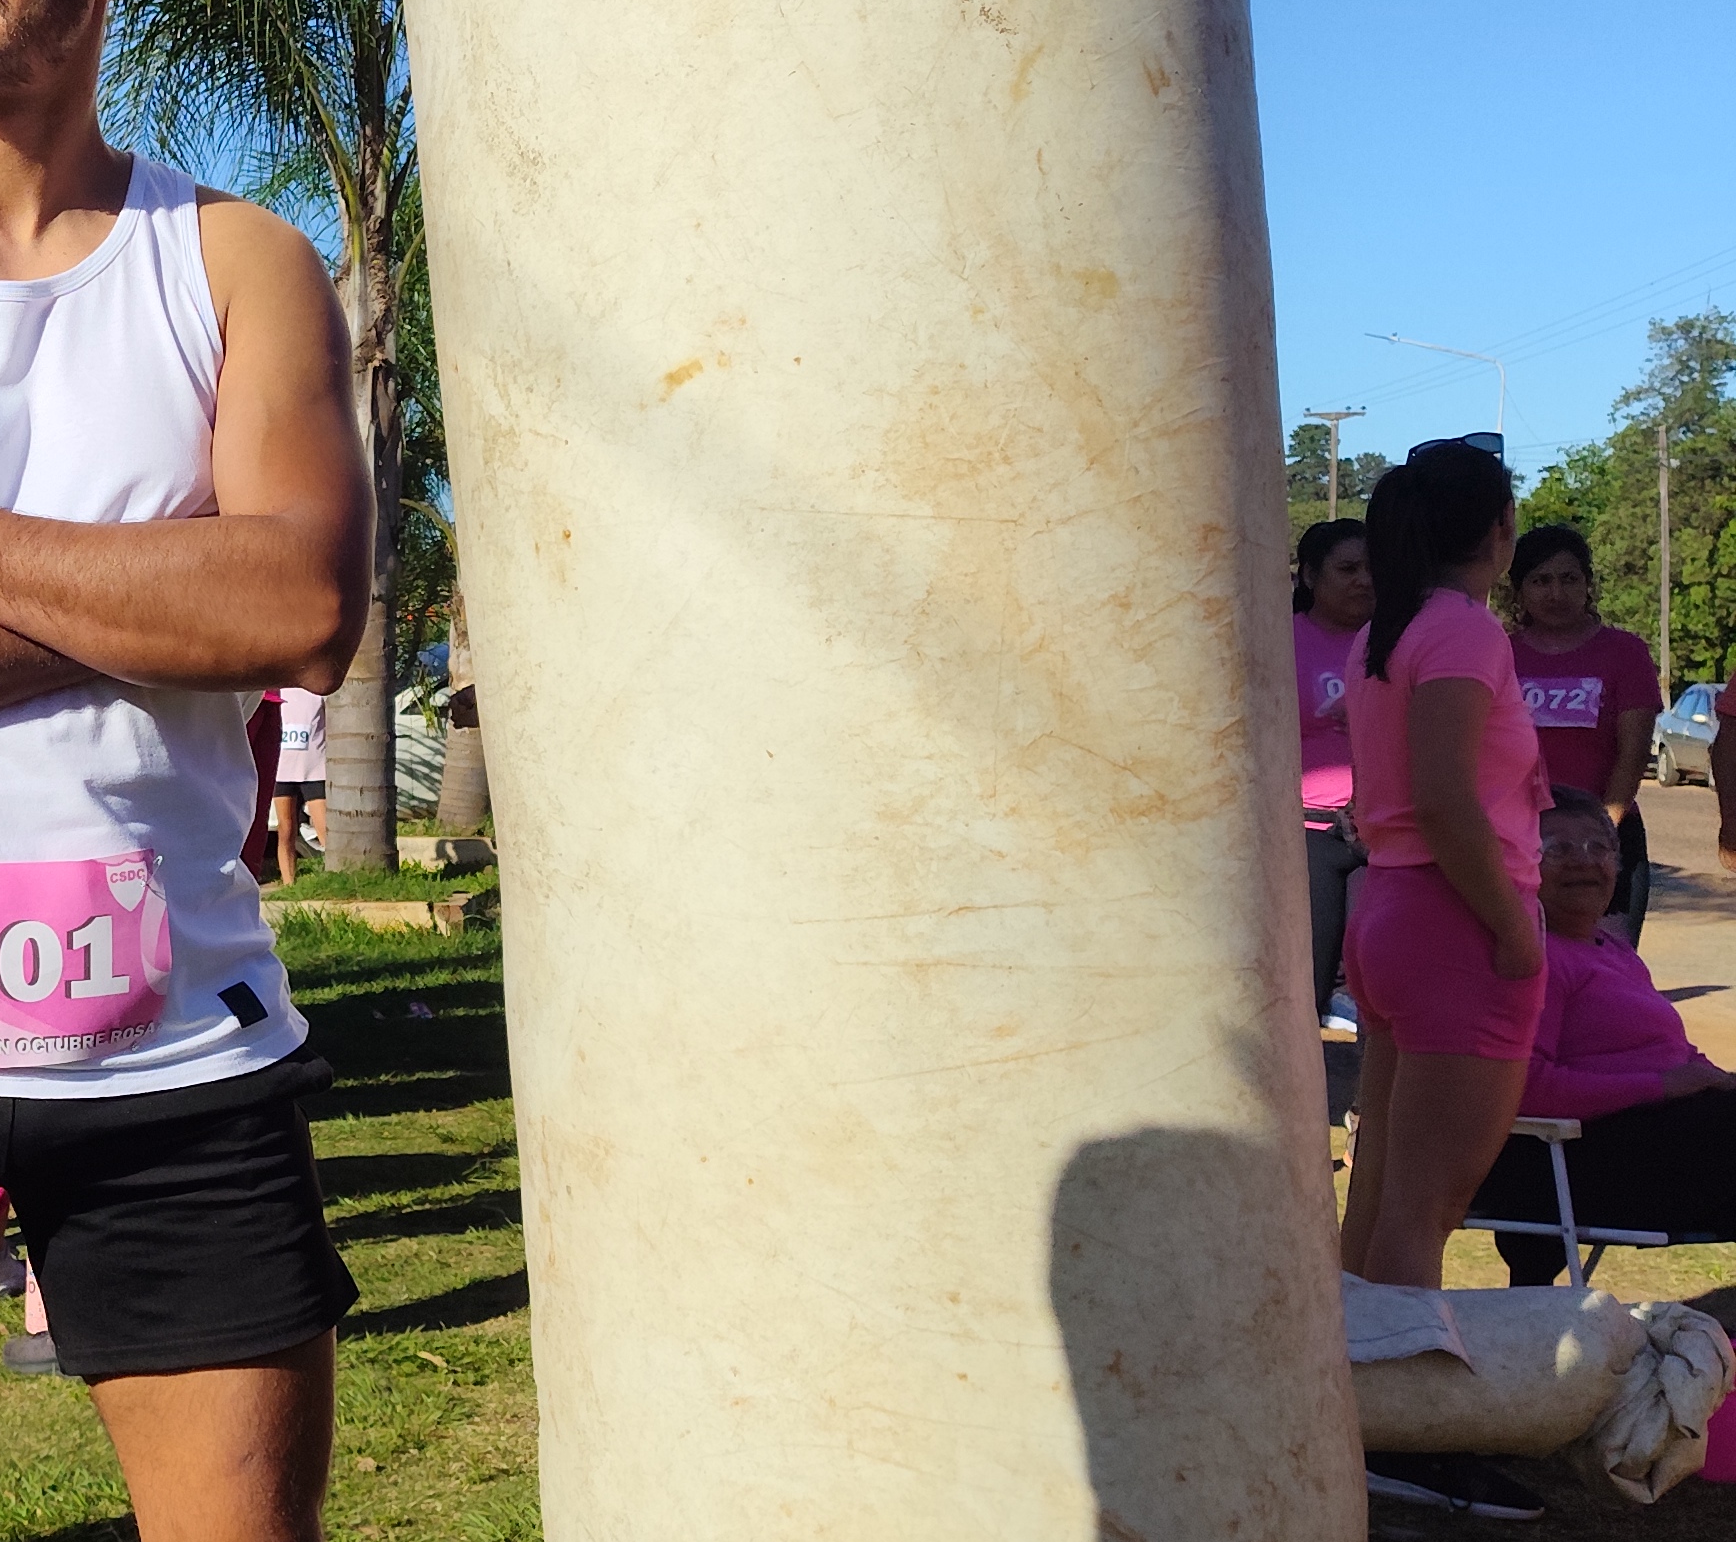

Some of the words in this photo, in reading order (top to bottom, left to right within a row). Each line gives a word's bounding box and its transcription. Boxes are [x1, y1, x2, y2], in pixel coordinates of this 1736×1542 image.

[1525, 687, 1587, 710] 072
[109, 867, 146, 884] CSDC
[14, 1031, 107, 1055] OCTUBRE
[109, 1020, 155, 1045] ROSA
